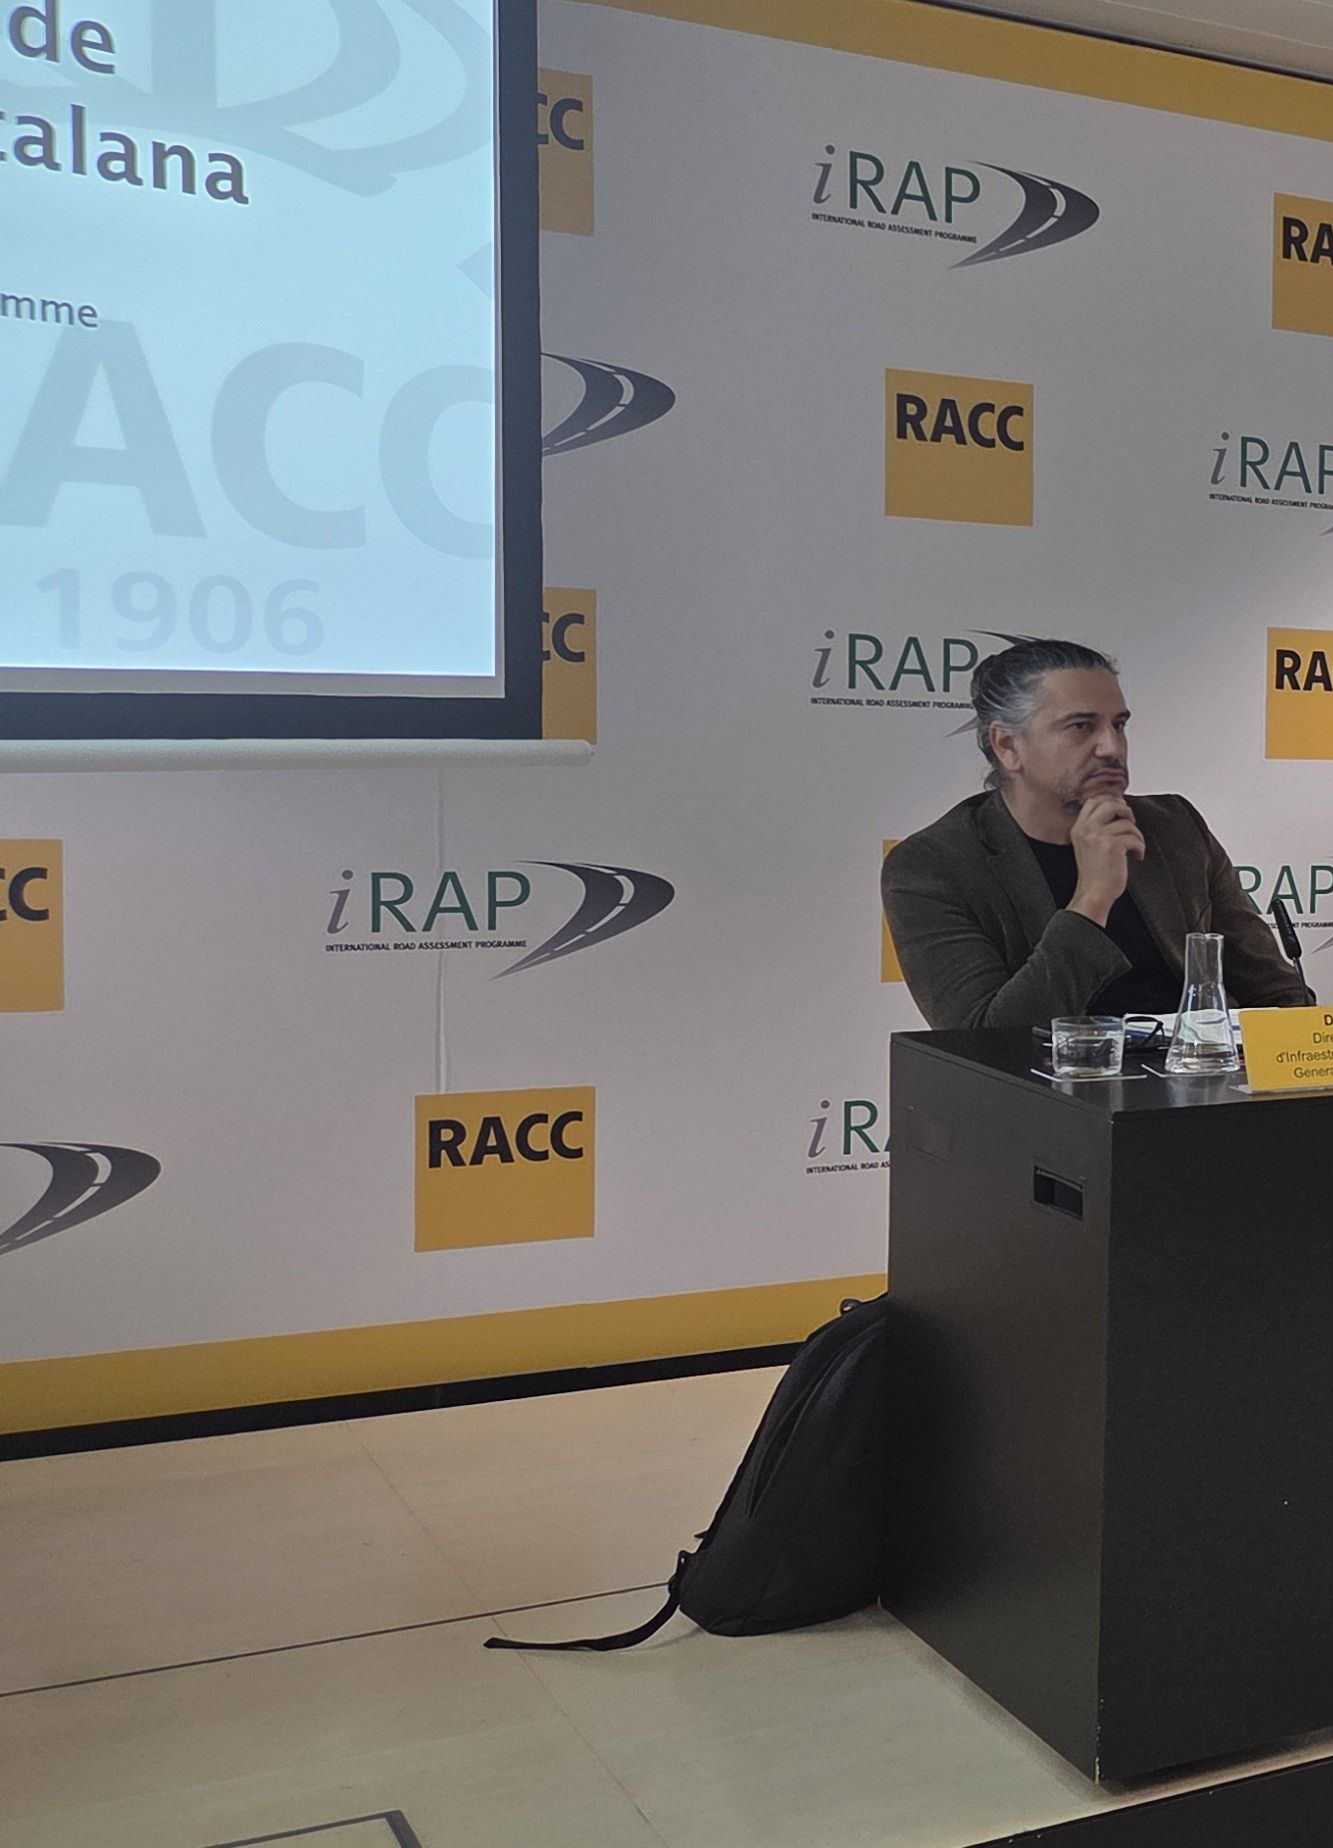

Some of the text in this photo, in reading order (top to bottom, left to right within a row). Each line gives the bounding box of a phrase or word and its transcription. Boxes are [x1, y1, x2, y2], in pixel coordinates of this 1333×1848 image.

[8, 0, 116, 74] de
[0, 103, 250, 205] alana
[812, 144, 981, 224] iRAP
[812, 213, 977, 244] INTERNATIONAL ROAD ASSESSMENT PROGRAMME
[896, 393, 1025, 452] RACC
[34, 566, 325, 656] 1906
[812, 629, 979, 693] iRAP
[866, 699, 885, 707] ROAD
[326, 869, 531, 934] iRAP
[325, 940, 527, 952] INTERNATIONAL ROAD ASSESSMENT PROGRAMME
[428, 1110, 584, 1169] RACC
